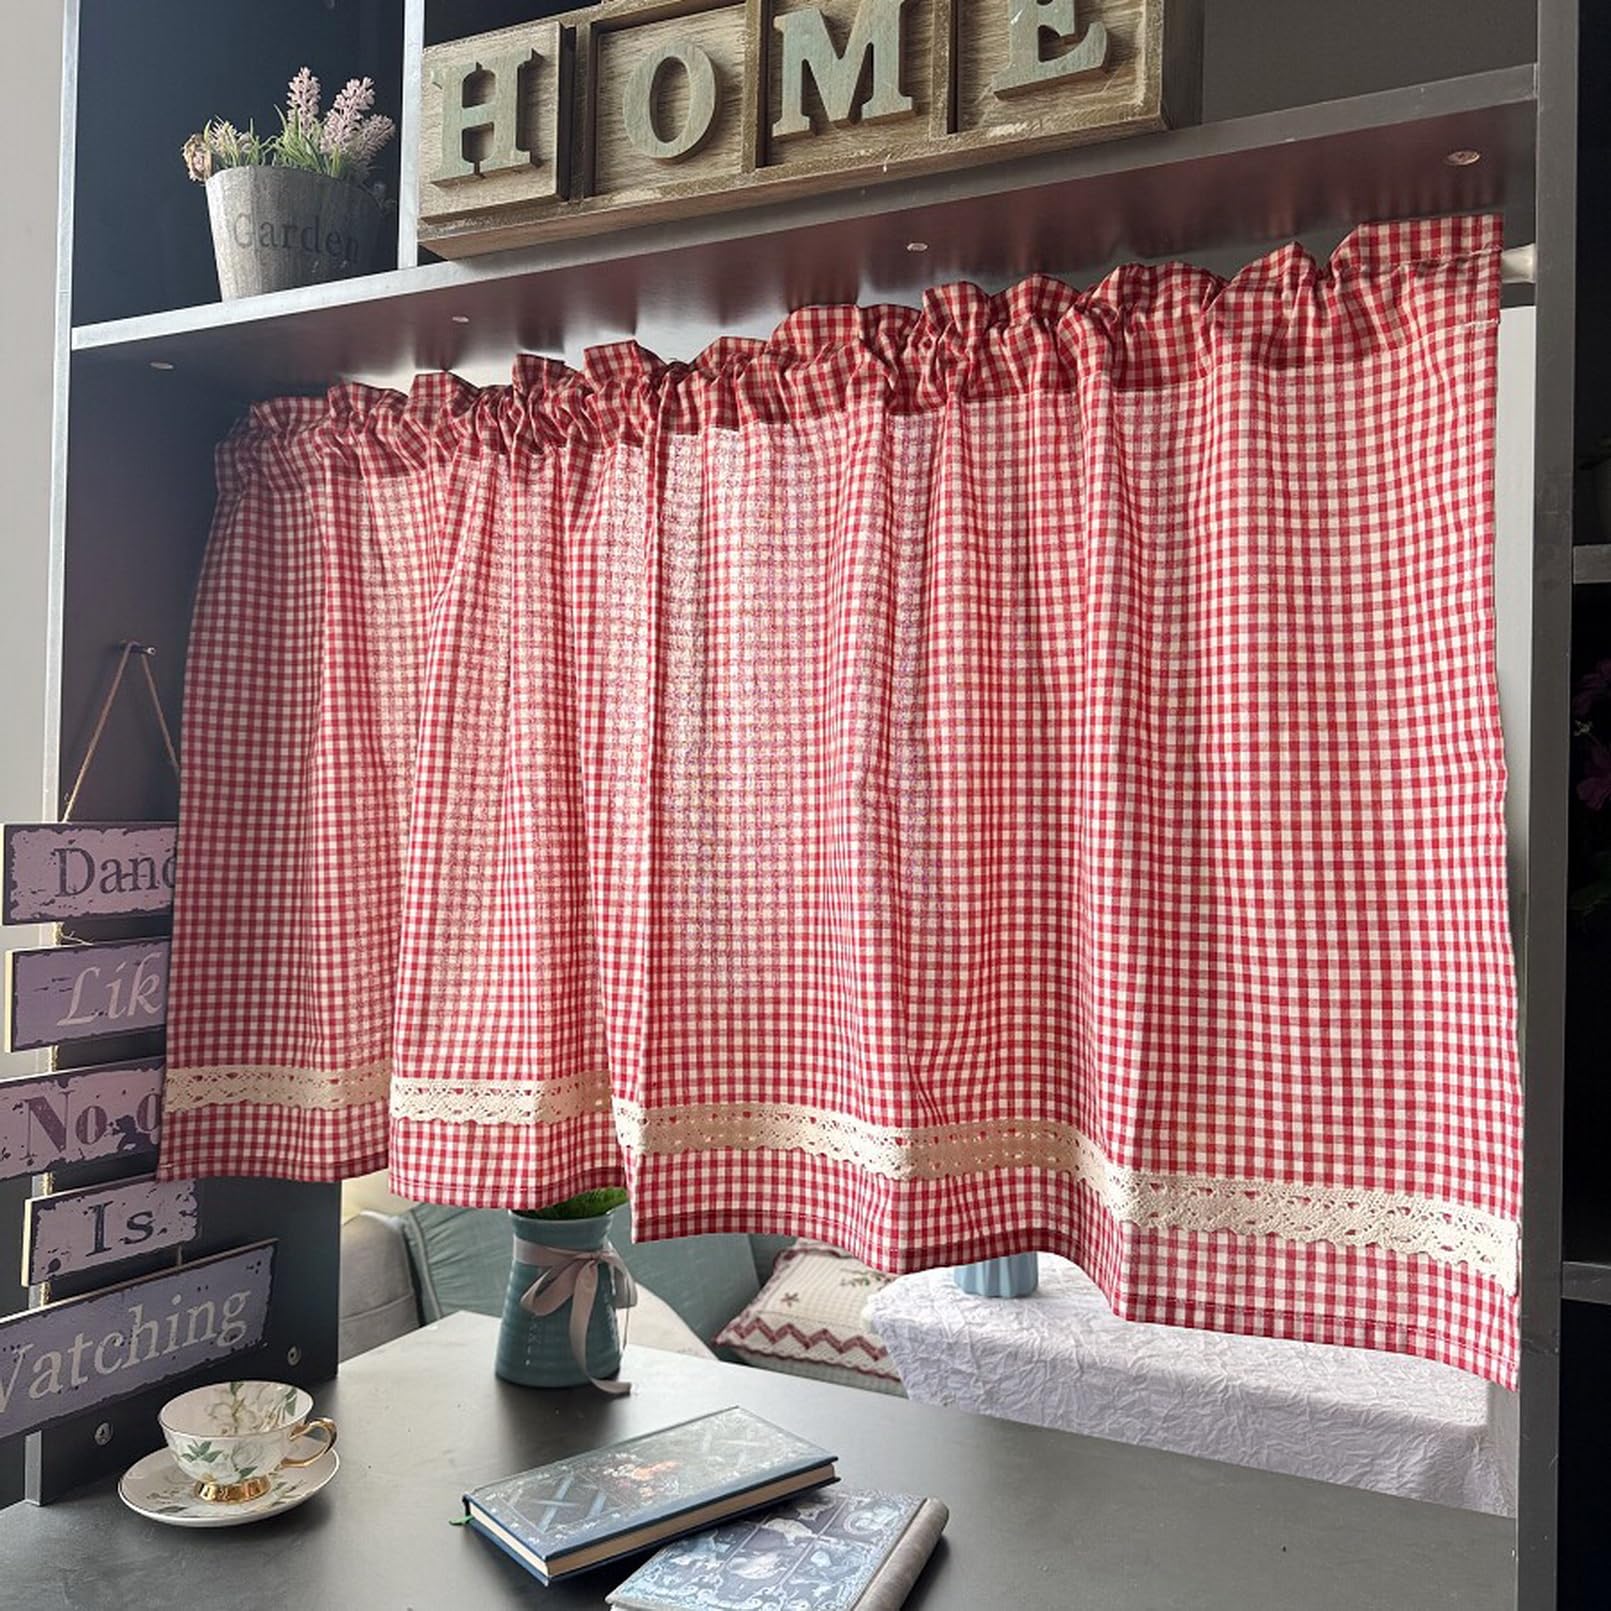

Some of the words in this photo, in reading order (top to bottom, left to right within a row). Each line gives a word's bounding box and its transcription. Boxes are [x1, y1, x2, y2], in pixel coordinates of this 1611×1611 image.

[429, 0, 1109, 183] HOME
[233, 212, 360, 264] Garden
[57, 951, 162, 1026] Lik
[20, 1088, 108, 1160] No
[84, 1200, 154, 1257] Is
